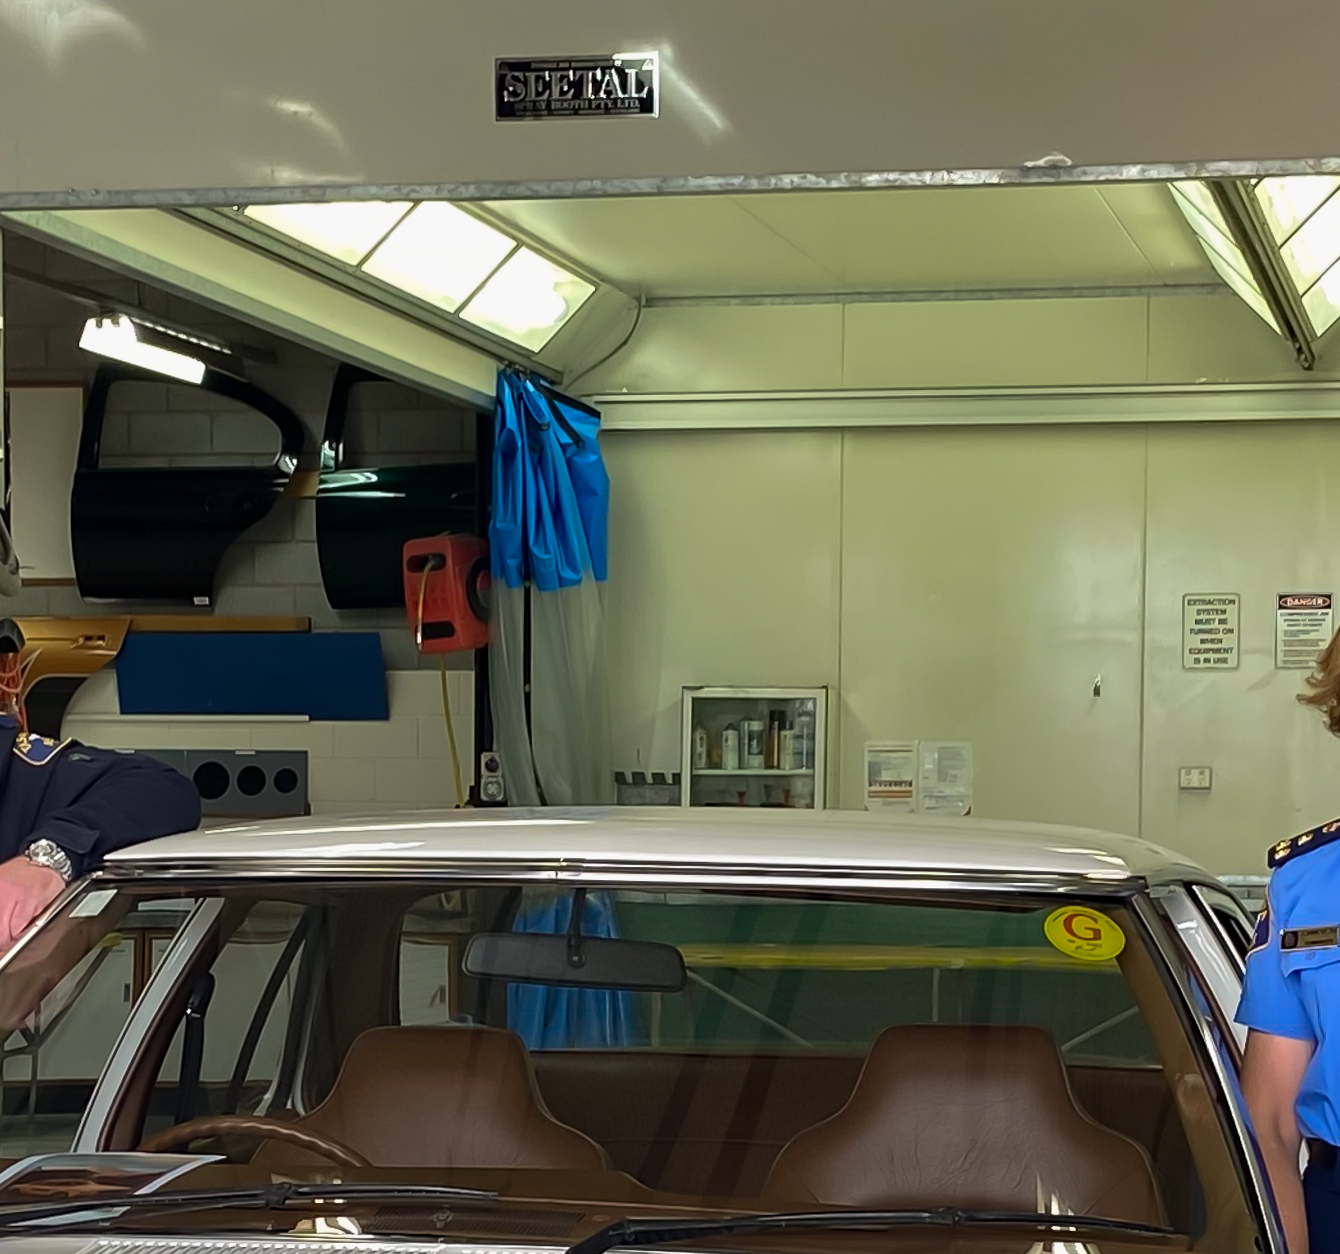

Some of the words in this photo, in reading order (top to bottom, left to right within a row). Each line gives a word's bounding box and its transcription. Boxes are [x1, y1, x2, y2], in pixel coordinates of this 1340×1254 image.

[504, 67, 649, 101] SEETAL
[551, 100, 588, 110] BOOTH
[1063, 913, 1102, 942] G
